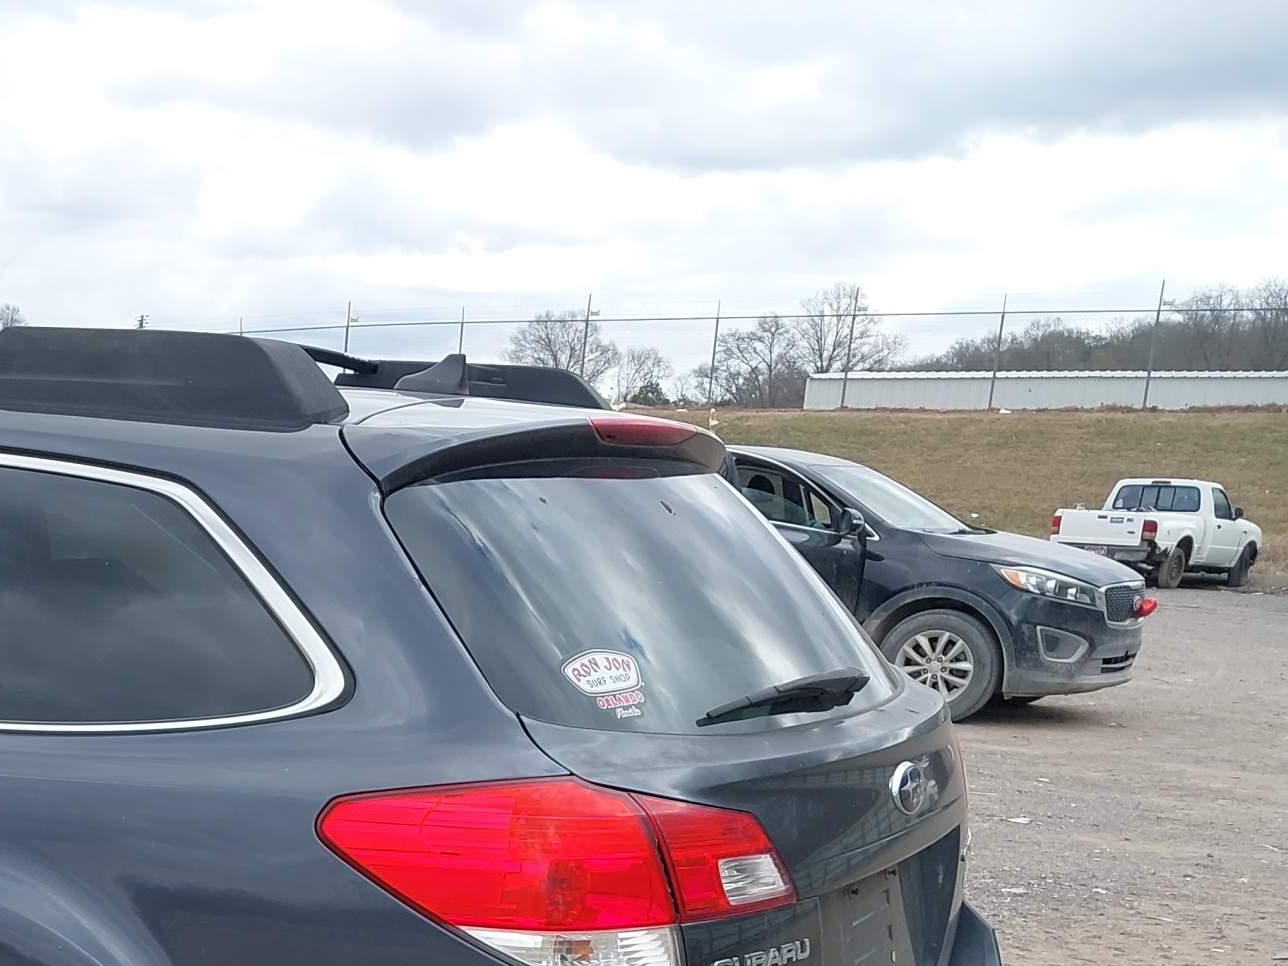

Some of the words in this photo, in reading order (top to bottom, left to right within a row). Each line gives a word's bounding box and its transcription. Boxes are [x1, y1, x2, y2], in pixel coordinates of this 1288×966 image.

[571, 656, 601, 683] RON
[604, 656, 632, 674] JON
[586, 676, 608, 689] SURF
[609, 673, 631, 685] SHOP
[597, 690, 645, 710] ORLANDO
